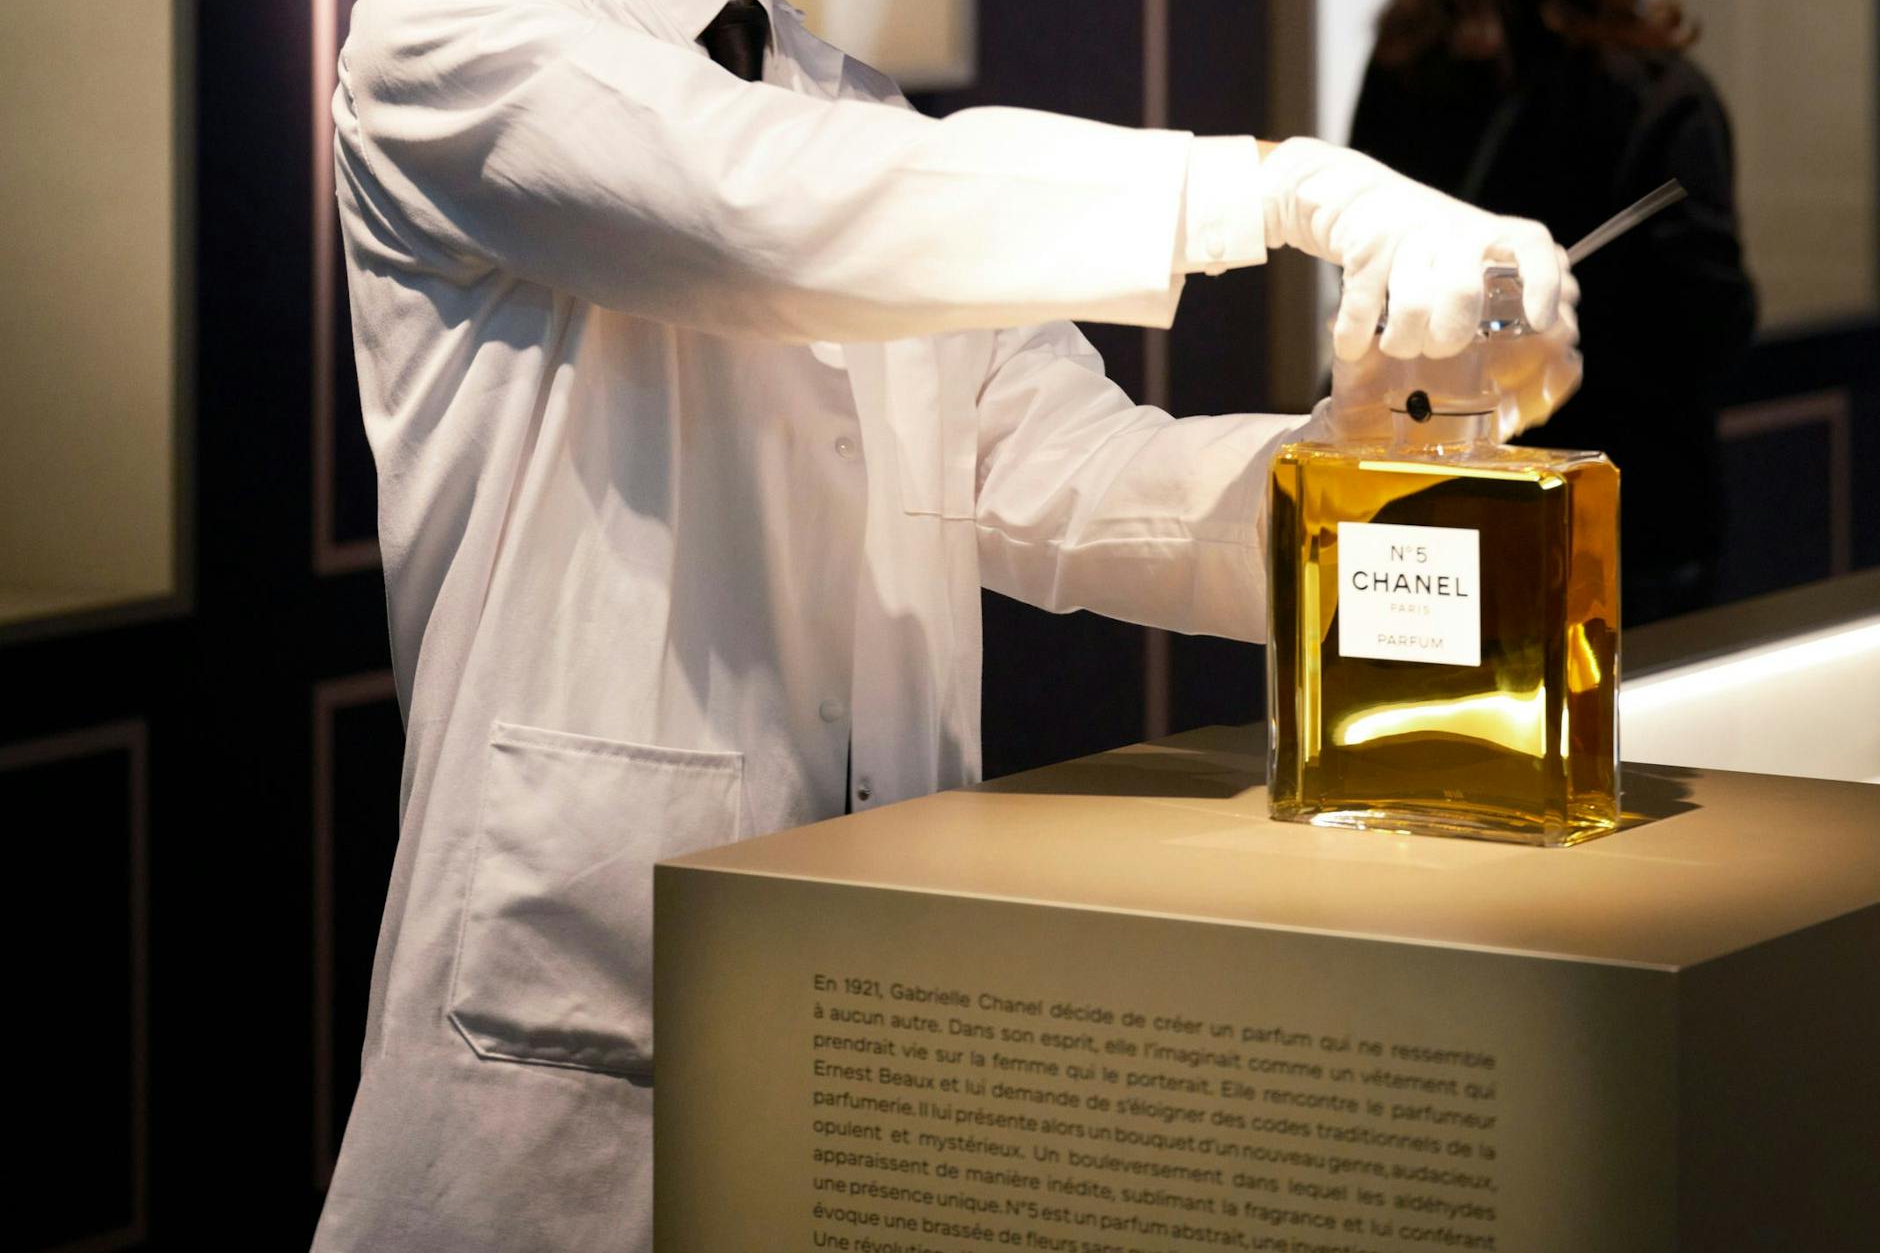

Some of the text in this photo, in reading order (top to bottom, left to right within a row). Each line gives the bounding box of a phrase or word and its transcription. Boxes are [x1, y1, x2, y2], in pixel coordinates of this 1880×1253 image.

[1352, 571, 1468, 597] CHANEL
[1390, 604, 1430, 615] PARIS
[1378, 634, 1443, 648] PARFUM
[813, 973, 837, 992] En
[889, 982, 971, 1008] Gabrielle
[978, 993, 1042, 1016] Chanel
[1049, 1003, 1115, 1025] décide
[1121, 1012, 1147, 1028] de
[1153, 1016, 1202, 1034] créer
[1210, 1024, 1234, 1038] un
[1242, 1027, 1312, 1046] parfum
[1319, 1036, 1350, 1052] qui
[1358, 1040, 1383, 1057] ne
[1391, 1045, 1497, 1071] ressemble
[813, 1002, 824, 1020] à
[830, 1007, 885, 1025] aucun
[948, 1018, 995, 1040] Dans
[1000, 1028, 1034, 1043] son
[1104, 1040, 1137, 1057] elle
[1248, 1058, 1323, 1079] comme
[1330, 1068, 1354, 1082] un
[1361, 1070, 1459, 1095] vêtement
[1464, 1084, 1496, 1100] qui
[813, 1034, 896, 1056] prendrait
[901, 1046, 928, 1061] vie
[935, 1049, 964, 1064] sur
[970, 1051, 985, 1068] la
[992, 1052, 1059, 1076] femme
[1065, 1065, 1095, 1080] qui
[1102, 1067, 1118, 1084] le
[1220, 1080, 1255, 1101] Elle
[1262, 1089, 1359, 1113] rencontre
[1367, 1100, 1384, 1116] le
[1391, 1104, 1497, 1130] parfumeur
[814, 1059, 873, 1082] Ernest
[879, 1067, 935, 1089] Beaux
[939, 1078, 959, 1093] et
[965, 1079, 986, 1096] lui
[991, 1083, 1080, 1108] demande
[1086, 1095, 1110, 1112] de
[1211, 1111, 1246, 1129] des
[1251, 1117, 1312, 1137] codes
[1317, 1124, 1441, 1154] traditionnels
[1446, 1141, 1472, 1158] de
[1479, 1145, 1497, 1161] la
[813, 1119, 882, 1141] opulent
[890, 1129, 910, 1145] et
[1033, 1146, 1059, 1162] Un
[1068, 1151, 1224, 1185] bouleversement
[1232, 1173, 1279, 1193] dans
[1288, 1180, 1348, 1201] lequel
[1358, 1189, 1384, 1207] les
[919, 1102, 928, 1117] Il
[932, 1104, 951, 1120] lui
[955, 1109, 1038, 1132] présente
[1042, 1120, 1085, 1138] alors
[1088, 1127, 1112, 1140] un
[1115, 1127, 1195, 1152] bouquet
[1243, 1145, 1325, 1169] nouveau
[813, 1148, 929, 1176] apparaissent
[936, 1163, 959, 1180] de
[966, 1168, 1040, 1190] manière
[1121, 1189, 1216, 1214] sublimant
[1222, 1200, 1238, 1217] la
[1244, 1201, 1336, 1230] fragrance
[1342, 1218, 1363, 1234] et
[1371, 1220, 1393, 1237] lui
[813, 1178, 846, 1193] une
[850, 1181, 934, 1205] présence
[1042, 1207, 1071, 1224] est
[1075, 1213, 1096, 1226] un
[1100, 1215, 1168, 1235] parfum
[1252, 1237, 1288, 1253] une
[813, 1201, 880, 1226] évoque
[885, 1216, 917, 1232] une
[922, 1218, 993, 1242] brassée
[998, 1229, 1022, 1246] de
[1026, 1231, 1077, 1253] fleurs
[813, 1230, 849, 1251] Une
